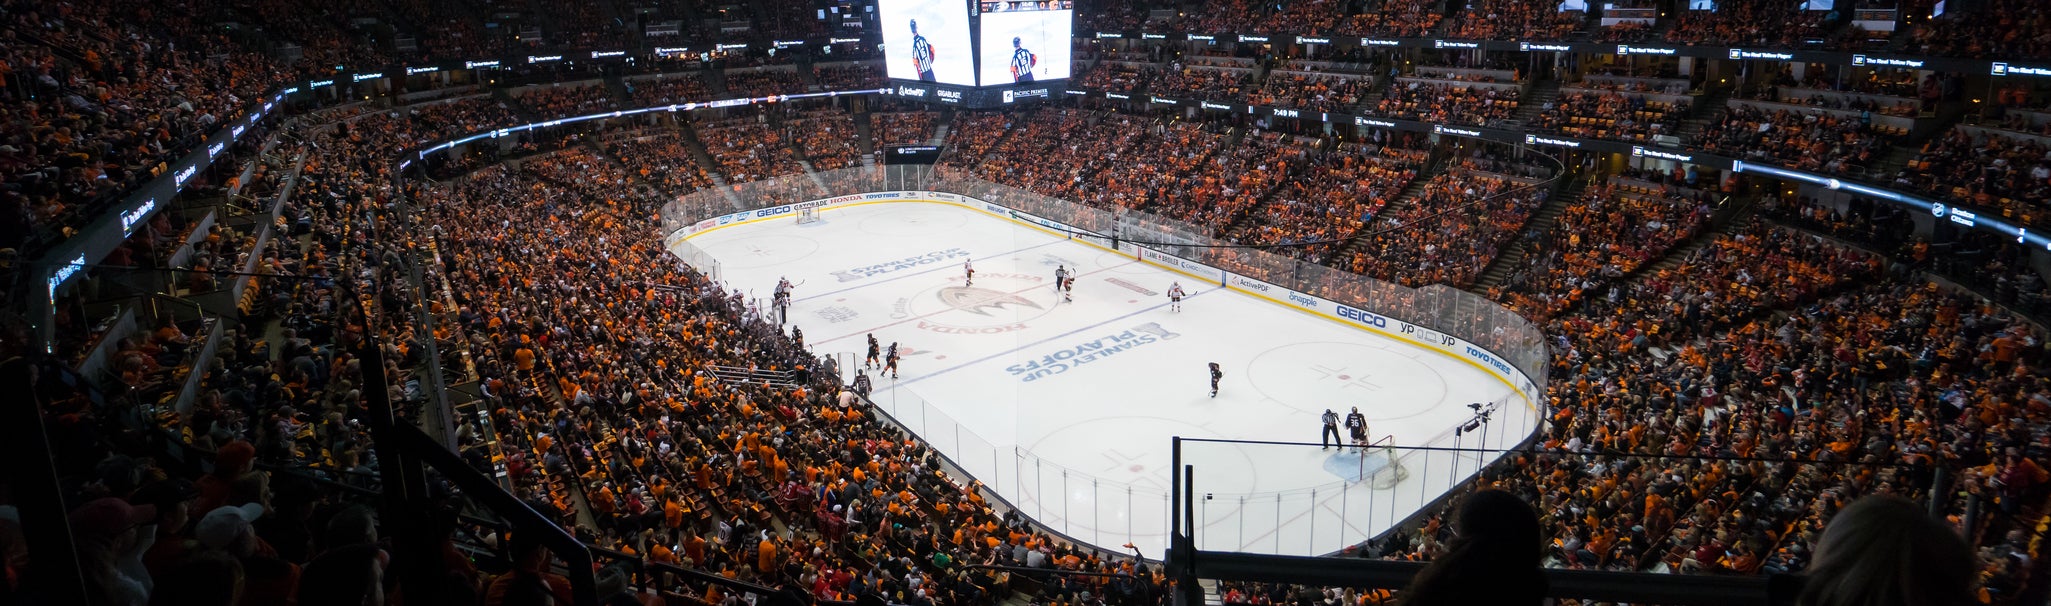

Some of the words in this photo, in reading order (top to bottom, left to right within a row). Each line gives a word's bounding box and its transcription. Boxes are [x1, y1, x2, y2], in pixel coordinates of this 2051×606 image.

[1273, 108, 1287, 116] 7:49
[1288, 110, 1298, 118] PM
[793, 199, 828, 211] GATORADE
[830, 194, 862, 205] HONDA
[756, 205, 791, 218] GEICO
[851, 255, 922, 274] STANLEY
[927, 248, 961, 257] CUP
[864, 250, 970, 277] PLAYOFFS
[1144, 250, 1158, 260] FLAME
[1161, 255, 1179, 267] BROILER
[1185, 262, 1199, 272] CHOC
[1239, 278, 1269, 293] ActivePDF
[1288, 291, 1318, 307] Snapple
[1336, 305, 1386, 329] GEICO
[917, 321, 1027, 335] HONDA
[1400, 322, 1415, 335] yp
[1441, 334, 1456, 347] yp
[1006, 330, 1137, 376] PLAYOFFS
[1072, 334, 1157, 367] STANLEY
[1465, 346, 1490, 362] TOYO
[1490, 357, 1511, 376] TIRES
[1022, 363, 1069, 382] CUP
[1350, 418, 1360, 428] 36
